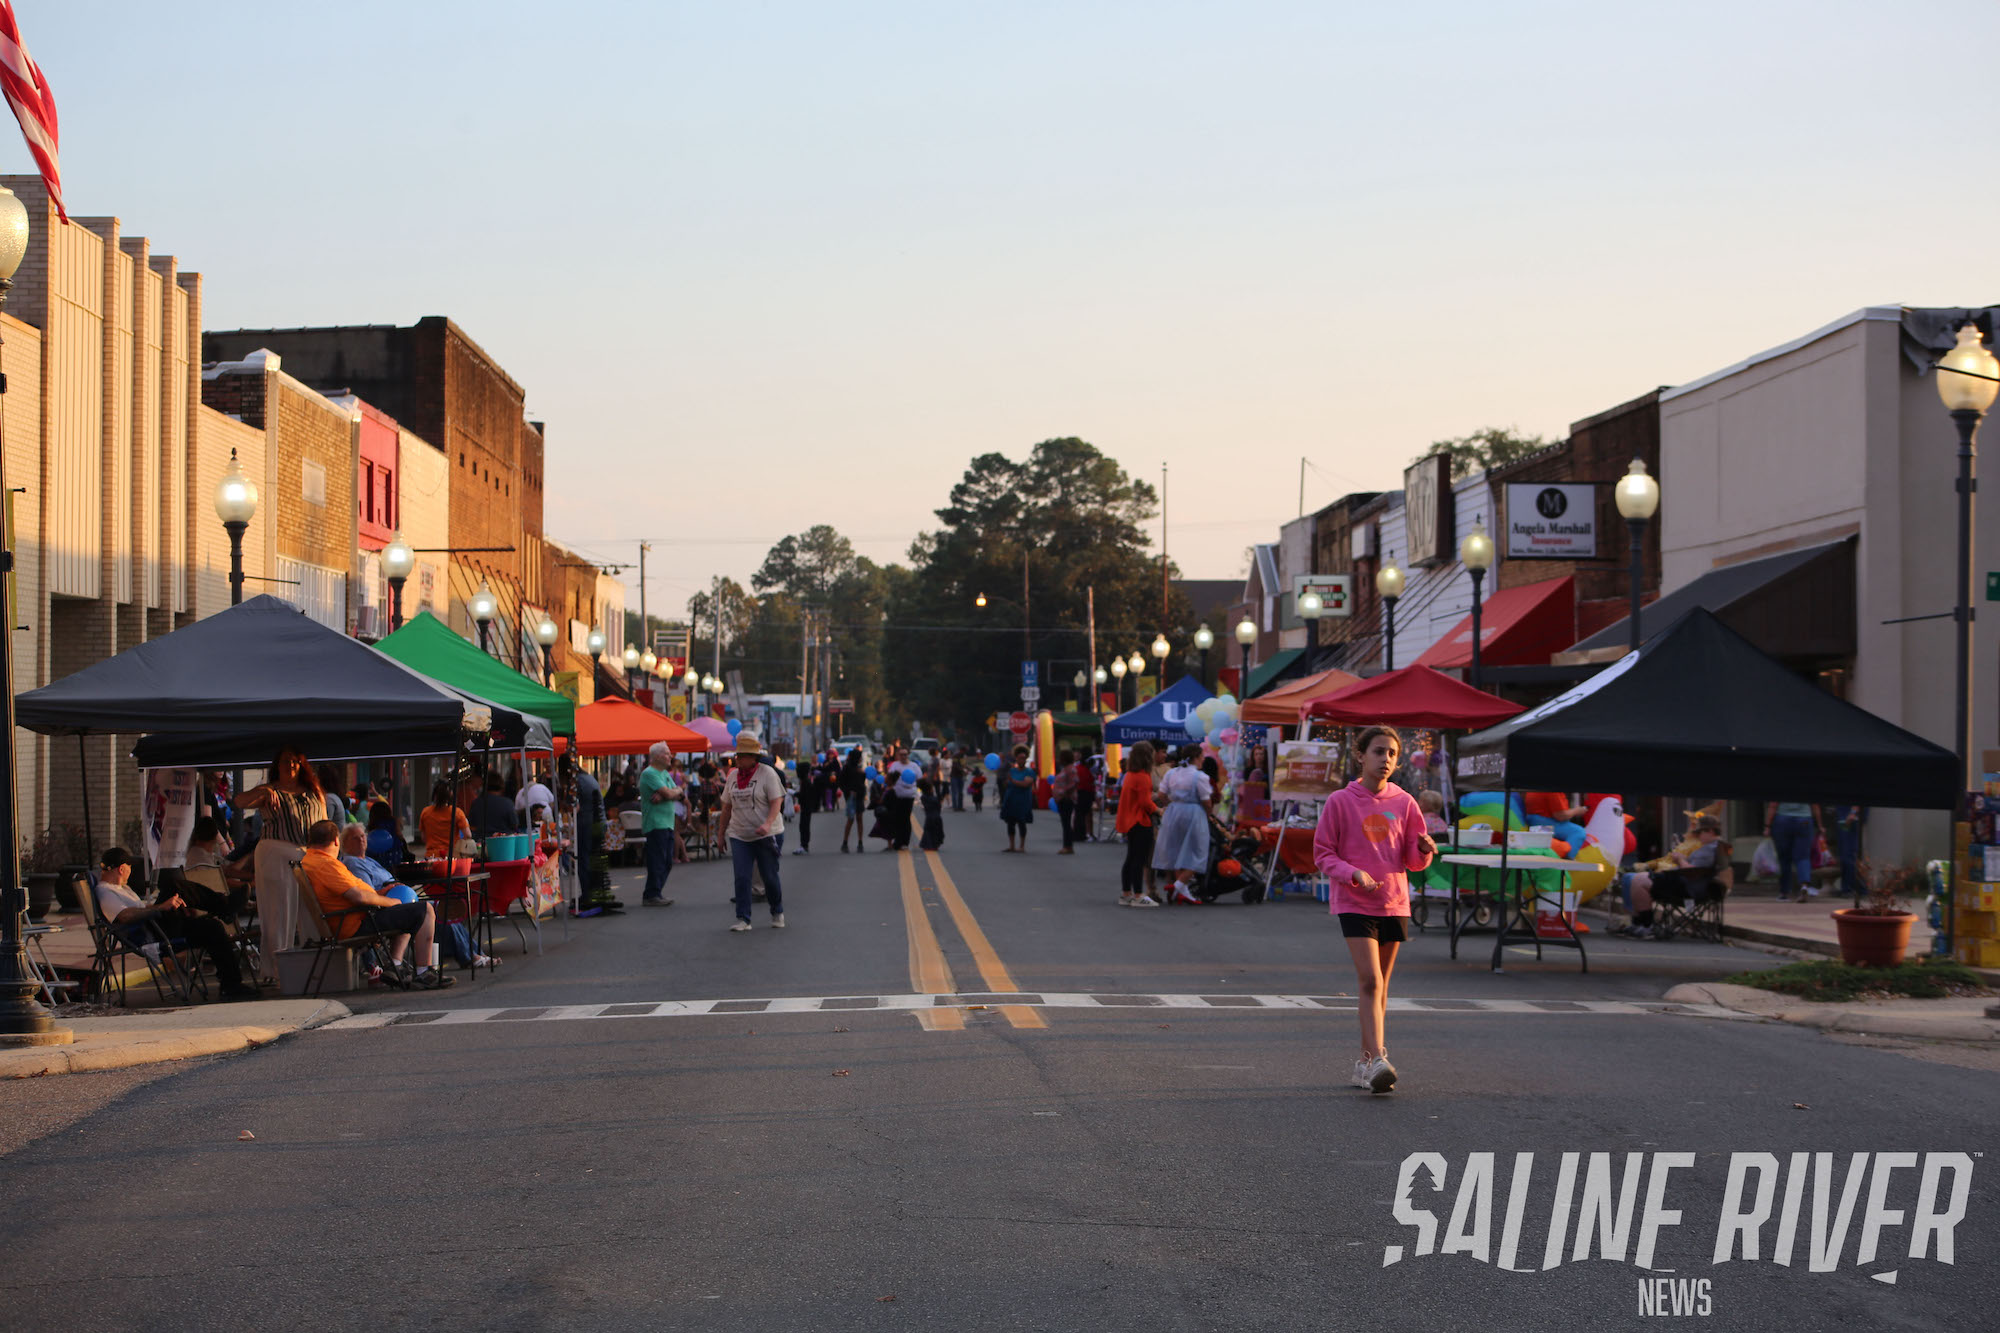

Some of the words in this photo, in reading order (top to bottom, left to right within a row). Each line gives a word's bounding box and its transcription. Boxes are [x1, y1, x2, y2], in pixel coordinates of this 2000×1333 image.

[1543, 493, 1561, 513] M
[1512, 522, 1546, 536] Angela
[1549, 522, 1592, 535] Marshall
[1531, 536, 1573, 545] Insurance
[1024, 663, 1035, 675] H
[1010, 719, 1029, 729] STOP
[1121, 728, 1156, 739] Union
[1160, 730, 1188, 740] Bank
